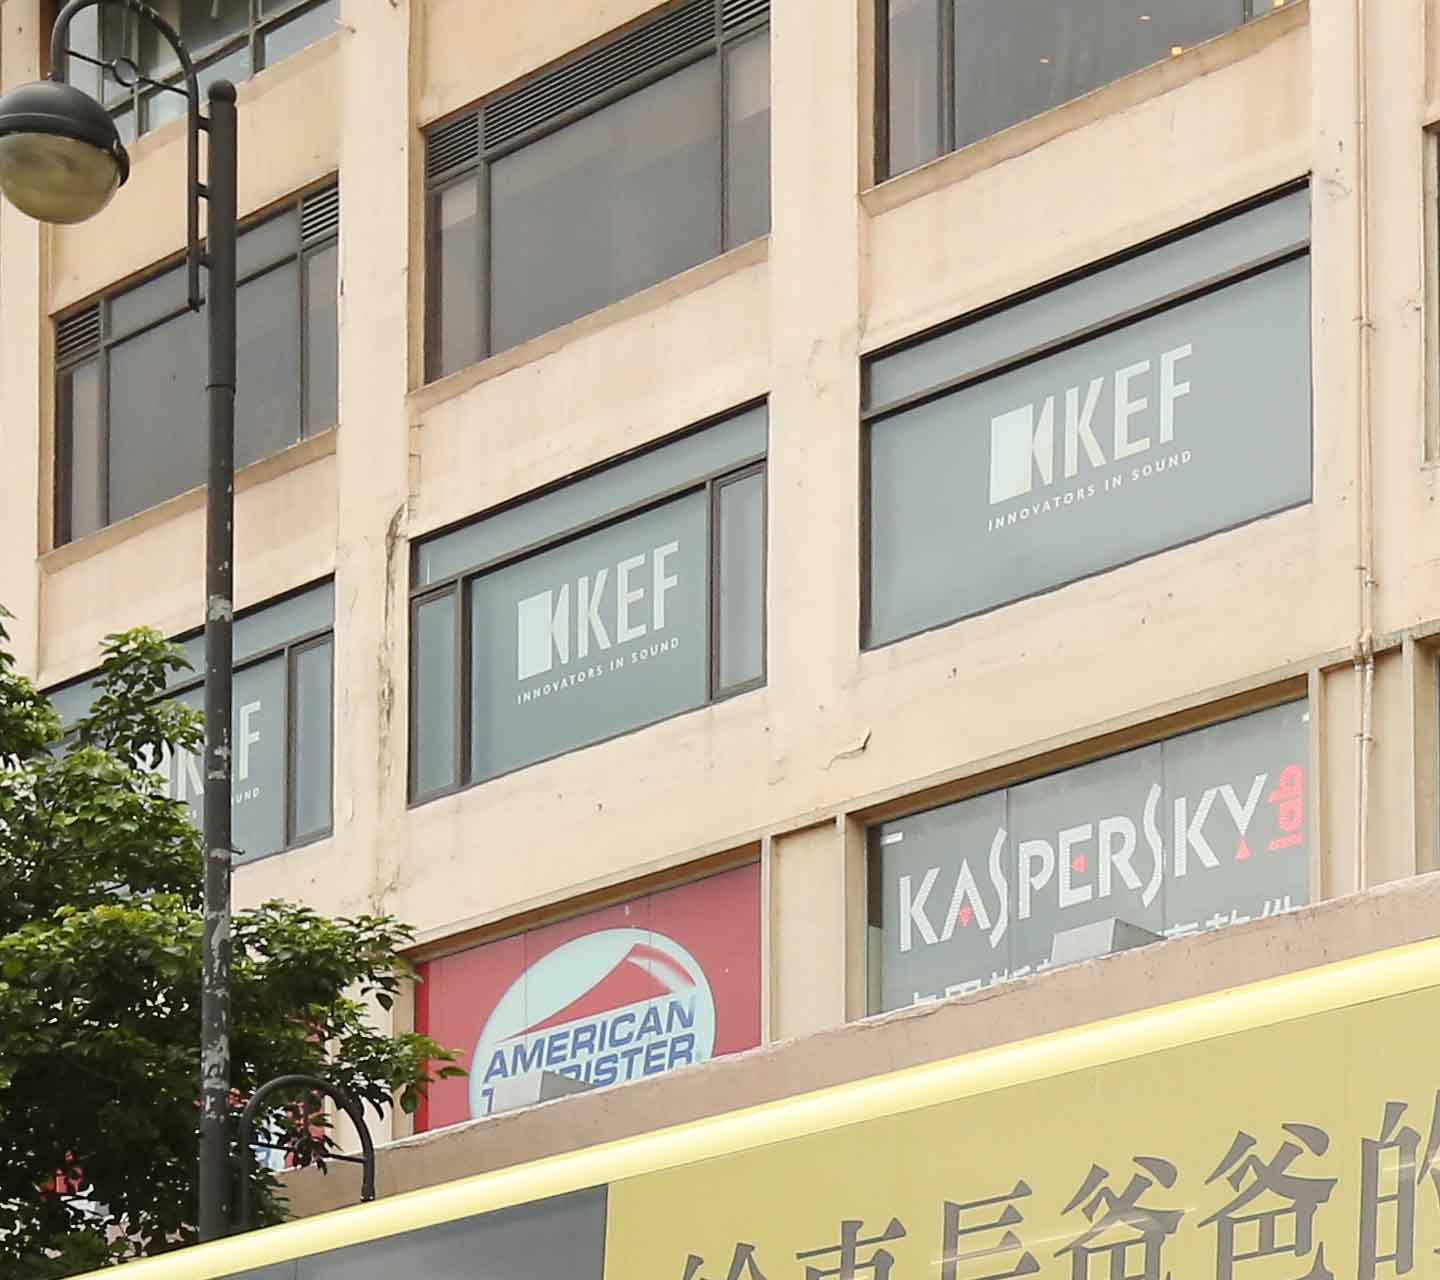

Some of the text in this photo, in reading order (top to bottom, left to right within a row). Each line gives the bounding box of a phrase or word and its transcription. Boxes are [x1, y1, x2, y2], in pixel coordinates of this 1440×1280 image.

[1064, 343, 1193, 479] KEF
[987, 449, 1193, 533] INNOVATORS IN SOUND
[578, 540, 680, 659] KEF
[517, 636, 680, 705] INNOVATORS IN SOUND
[898, 772, 1268, 952] KASPERSKY
[482, 997, 697, 1084] AMERICAN
